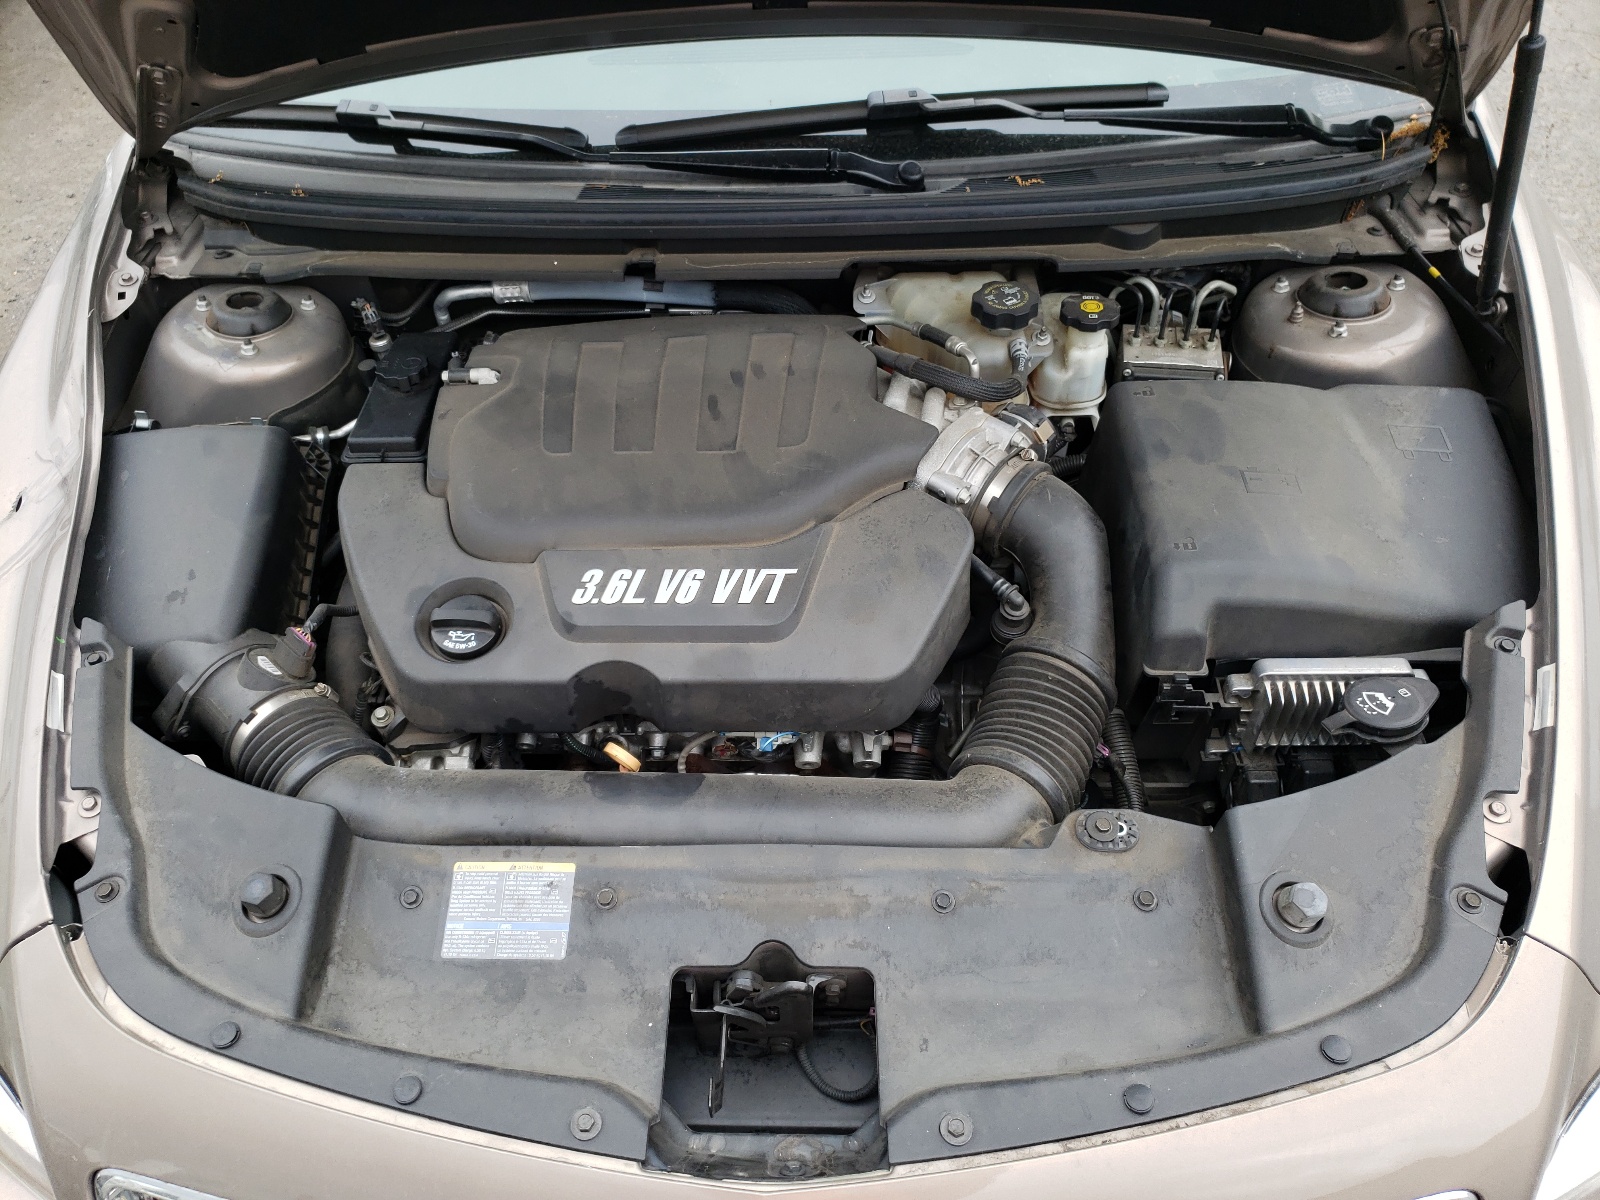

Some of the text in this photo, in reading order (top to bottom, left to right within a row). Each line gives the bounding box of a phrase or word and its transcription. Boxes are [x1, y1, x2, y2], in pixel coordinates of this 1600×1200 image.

[571, 568, 799, 605] 3.6L V6 VVT
[443, 639, 476, 649] SAE 5W-30
